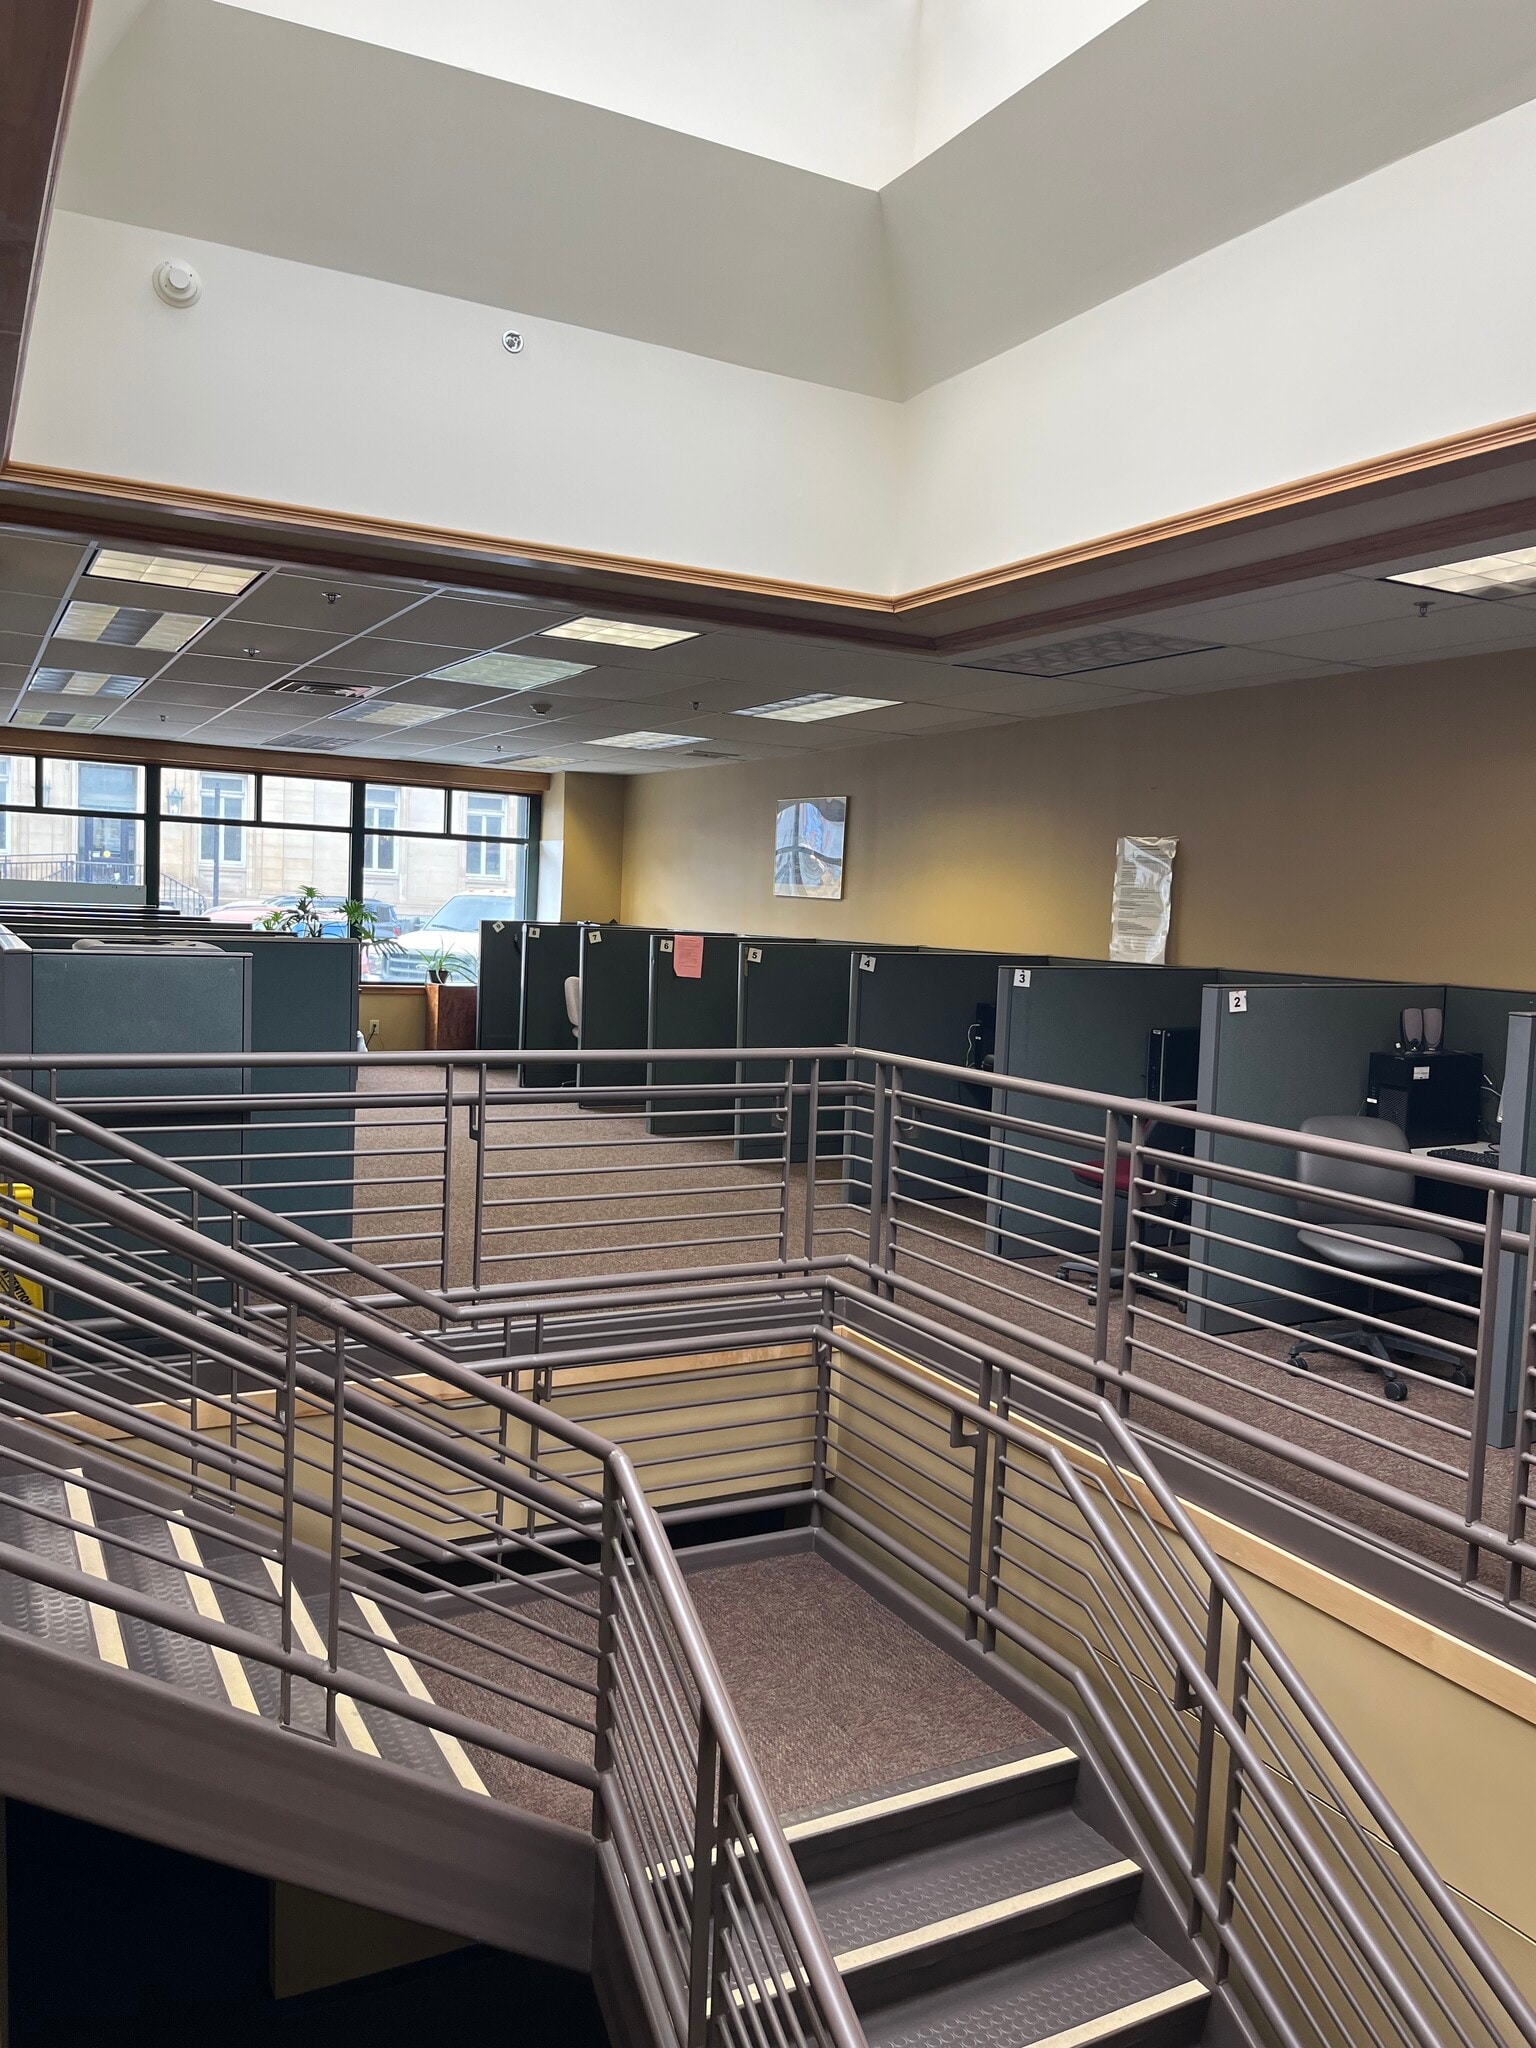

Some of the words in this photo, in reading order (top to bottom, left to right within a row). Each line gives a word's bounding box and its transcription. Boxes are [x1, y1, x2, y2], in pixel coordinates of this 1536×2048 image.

[864, 959, 870, 967] 4
[1019, 974, 1025, 983] 3
[1234, 997, 1241, 1007] 2
